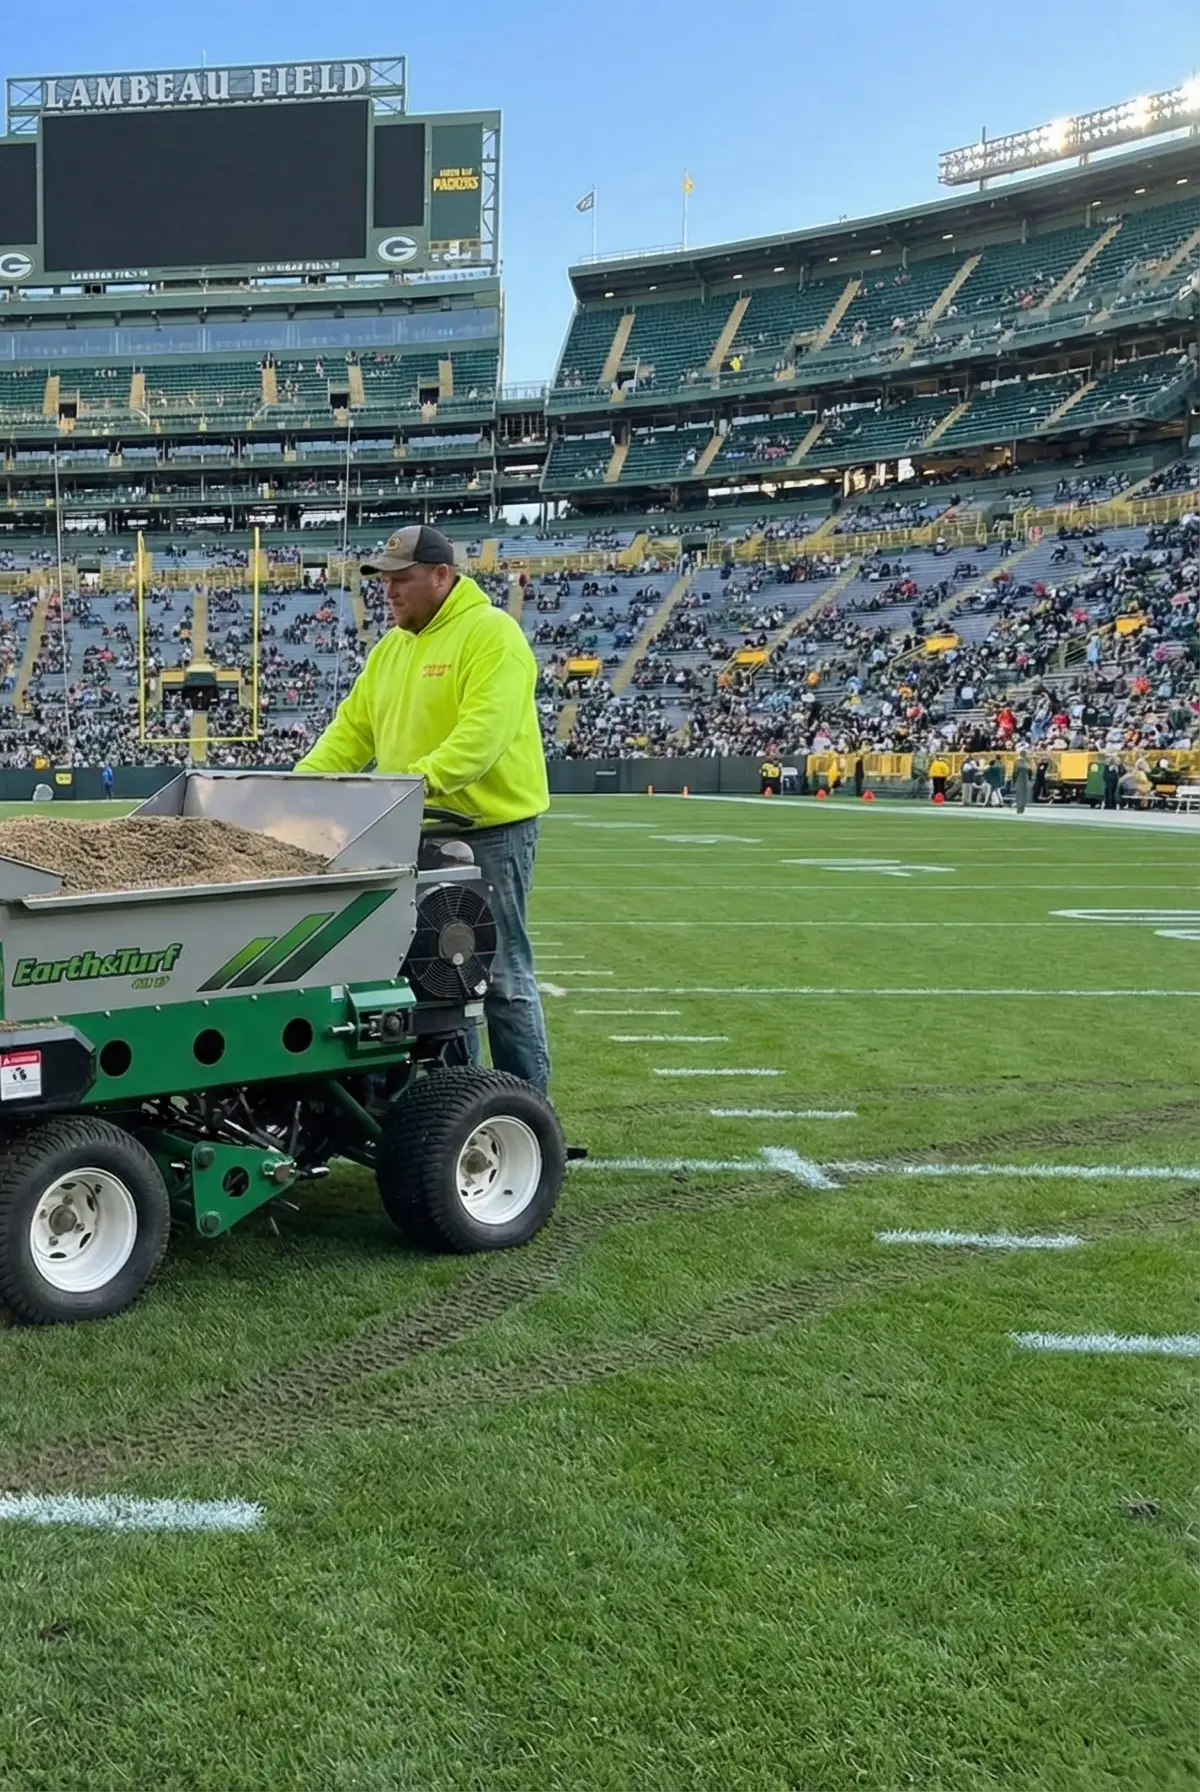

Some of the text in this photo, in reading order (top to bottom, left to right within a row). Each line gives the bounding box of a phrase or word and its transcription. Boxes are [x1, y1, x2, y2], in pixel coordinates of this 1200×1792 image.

[46, 62, 367, 108] LAMBEAU FIELD
[377, 235, 418, 263] G
[12, 942, 183, 988] Earth&Turf
